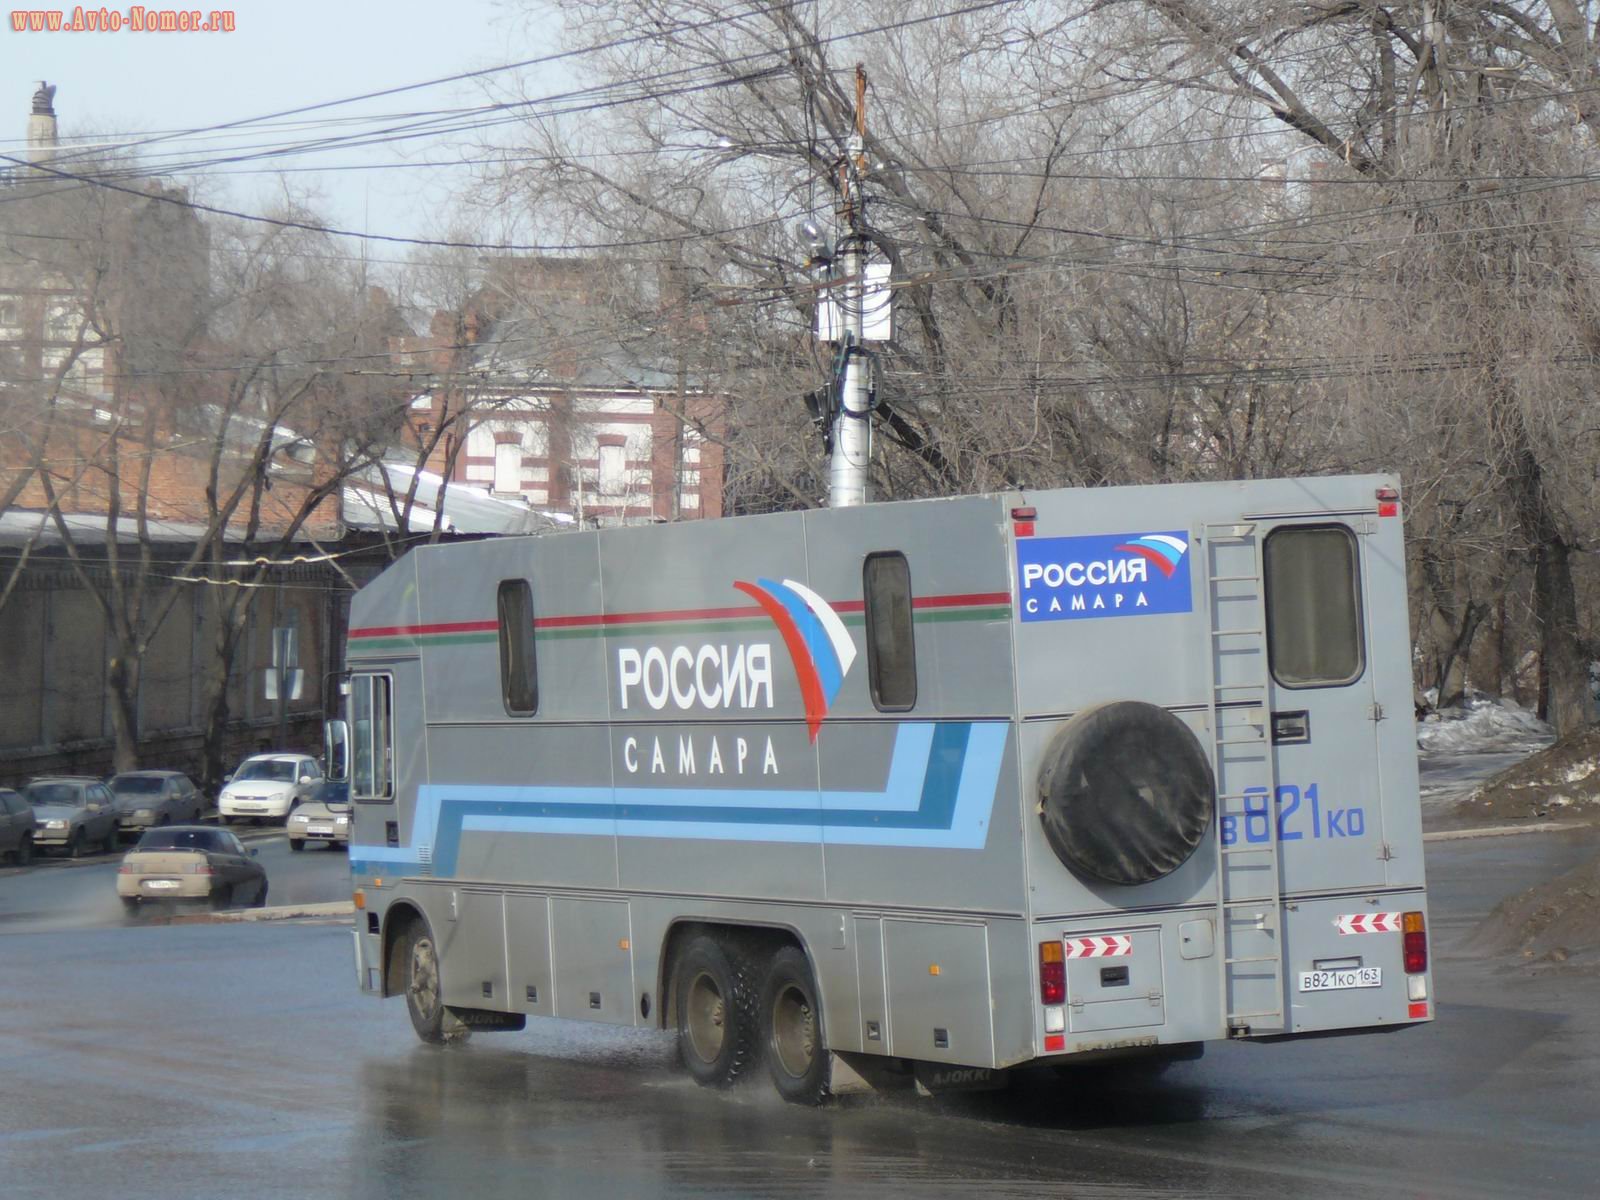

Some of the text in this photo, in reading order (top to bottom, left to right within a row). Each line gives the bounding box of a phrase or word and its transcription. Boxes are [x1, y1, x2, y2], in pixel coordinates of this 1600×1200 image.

[1023, 558, 1147, 589] РОССИЯ
[1026, 591, 1148, 613] САМАРА
[618, 643, 774, 710] РОССИЯ
[624, 734, 779, 776] САМАРА
